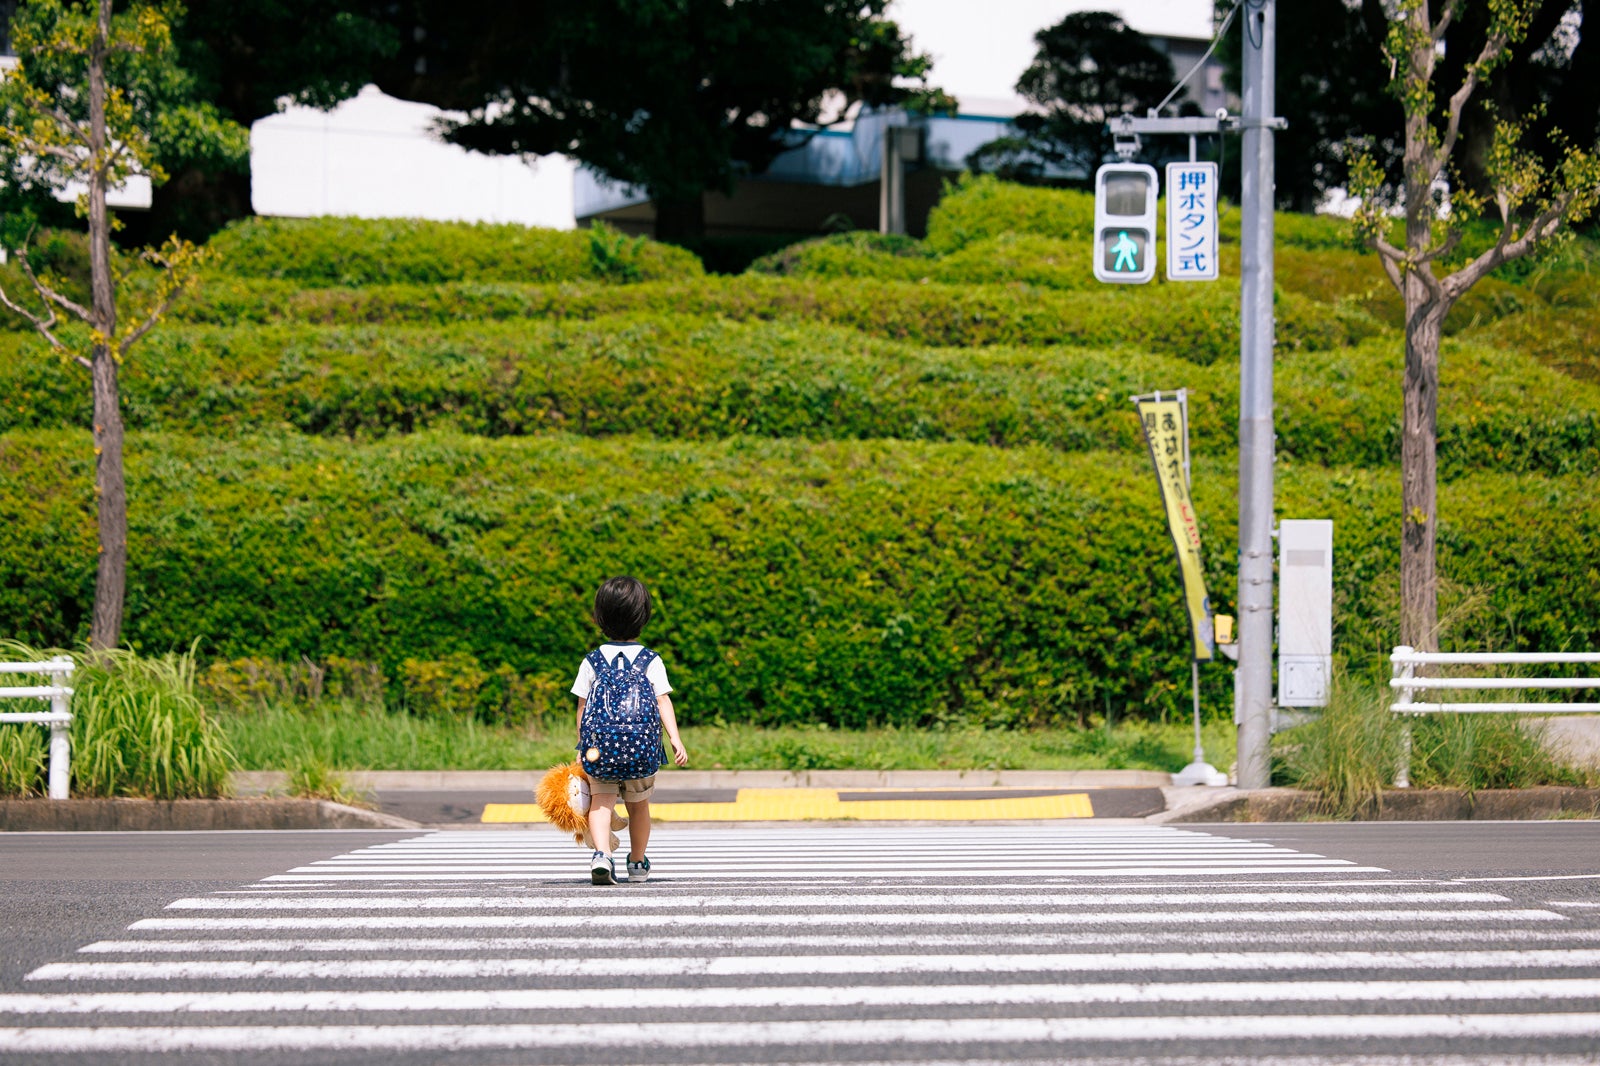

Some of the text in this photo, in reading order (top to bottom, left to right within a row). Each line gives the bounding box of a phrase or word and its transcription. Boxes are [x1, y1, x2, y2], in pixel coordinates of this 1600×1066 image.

[1178, 171, 1206, 272] 押ボタン式
